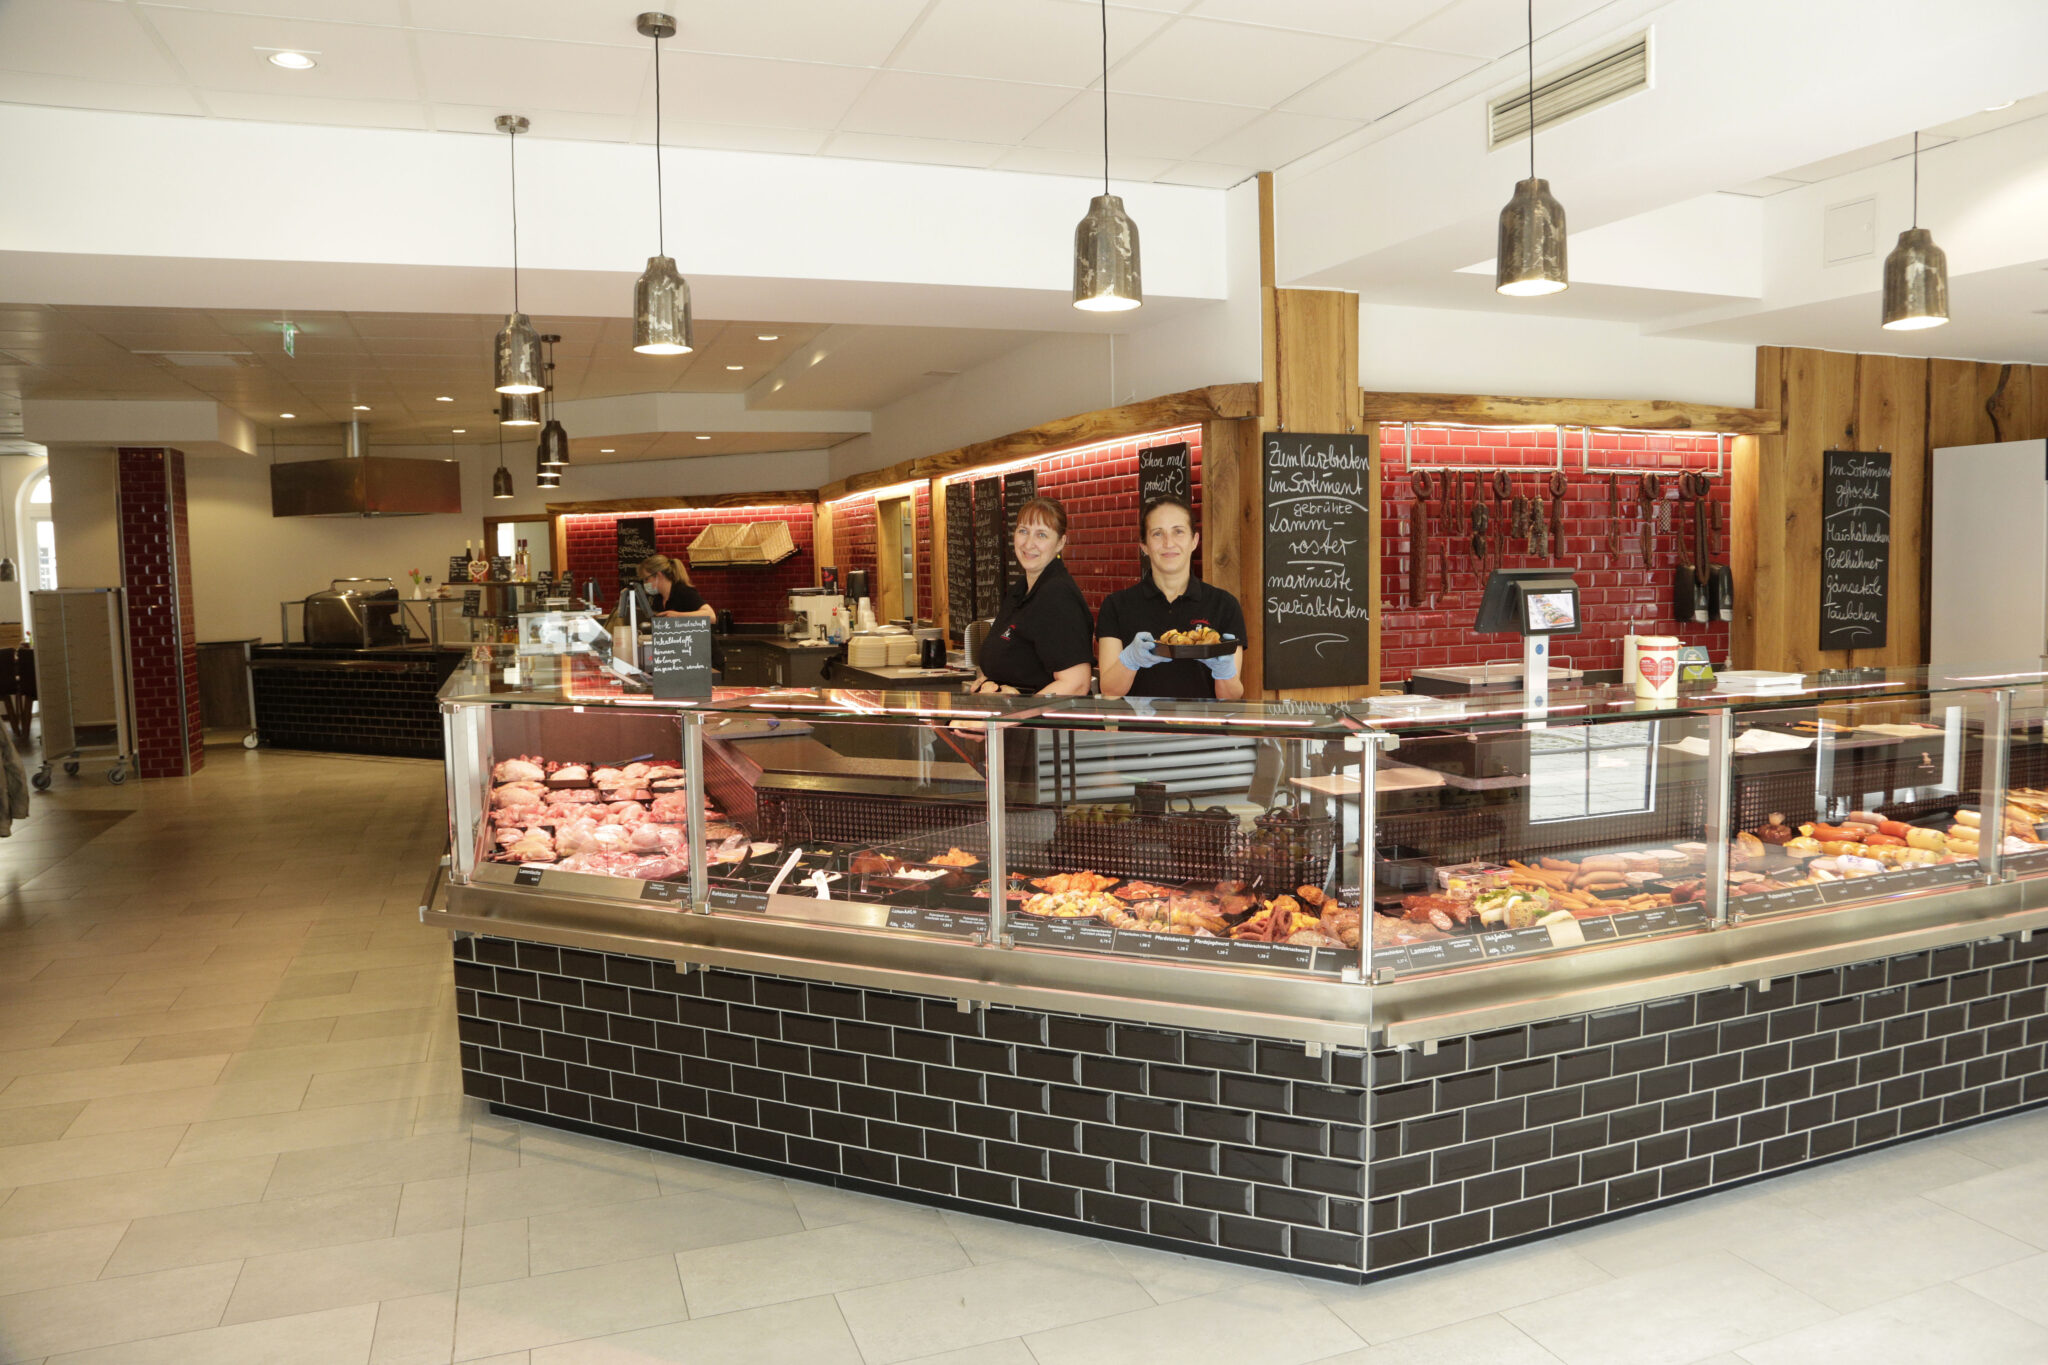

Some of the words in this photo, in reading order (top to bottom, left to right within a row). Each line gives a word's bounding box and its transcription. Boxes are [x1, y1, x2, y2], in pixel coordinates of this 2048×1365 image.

[1140, 450, 1165, 469] Schon
[1166, 449, 1186, 469] mal
[1268, 441, 1299, 468] Zum
[1299, 443, 1370, 471] Kurzbraten
[1268, 470, 1289, 493] im
[1288, 470, 1363, 495] Sortiment
[1269, 507, 1345, 533] Lamm-
[1293, 501, 1353, 517] gebrühte
[1288, 530, 1358, 555] roster
[1825, 547, 1884, 570] Perlhühner
[1268, 567, 1353, 592] marinierte
[1267, 594, 1370, 624] Spezialitäten
[1824, 600, 1881, 623] Täubchen
